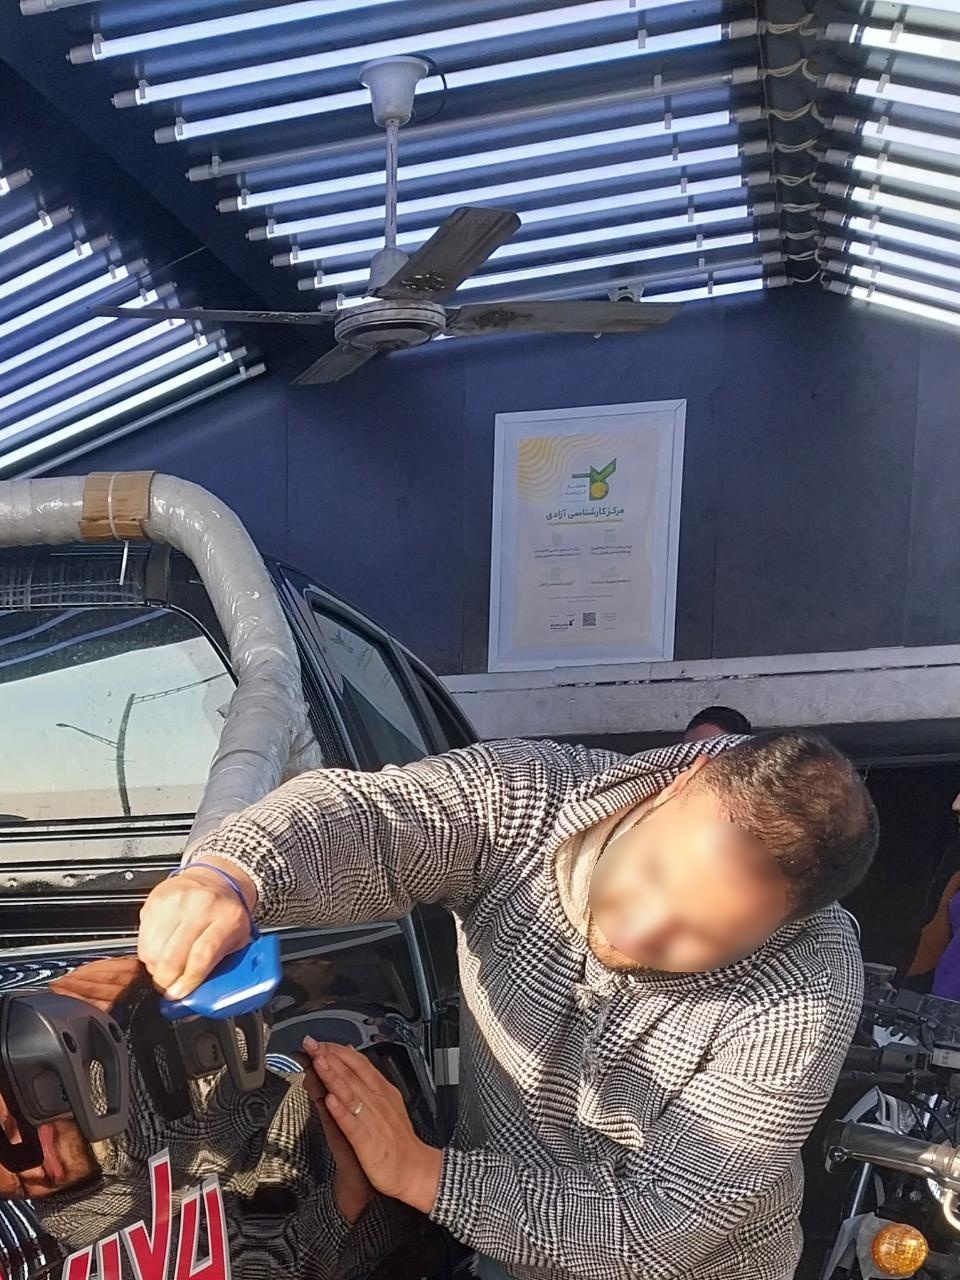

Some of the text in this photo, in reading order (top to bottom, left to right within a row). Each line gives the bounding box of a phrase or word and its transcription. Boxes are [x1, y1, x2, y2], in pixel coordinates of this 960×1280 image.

[545, 506, 625, 521] مرکز کارشناسی آزادی
